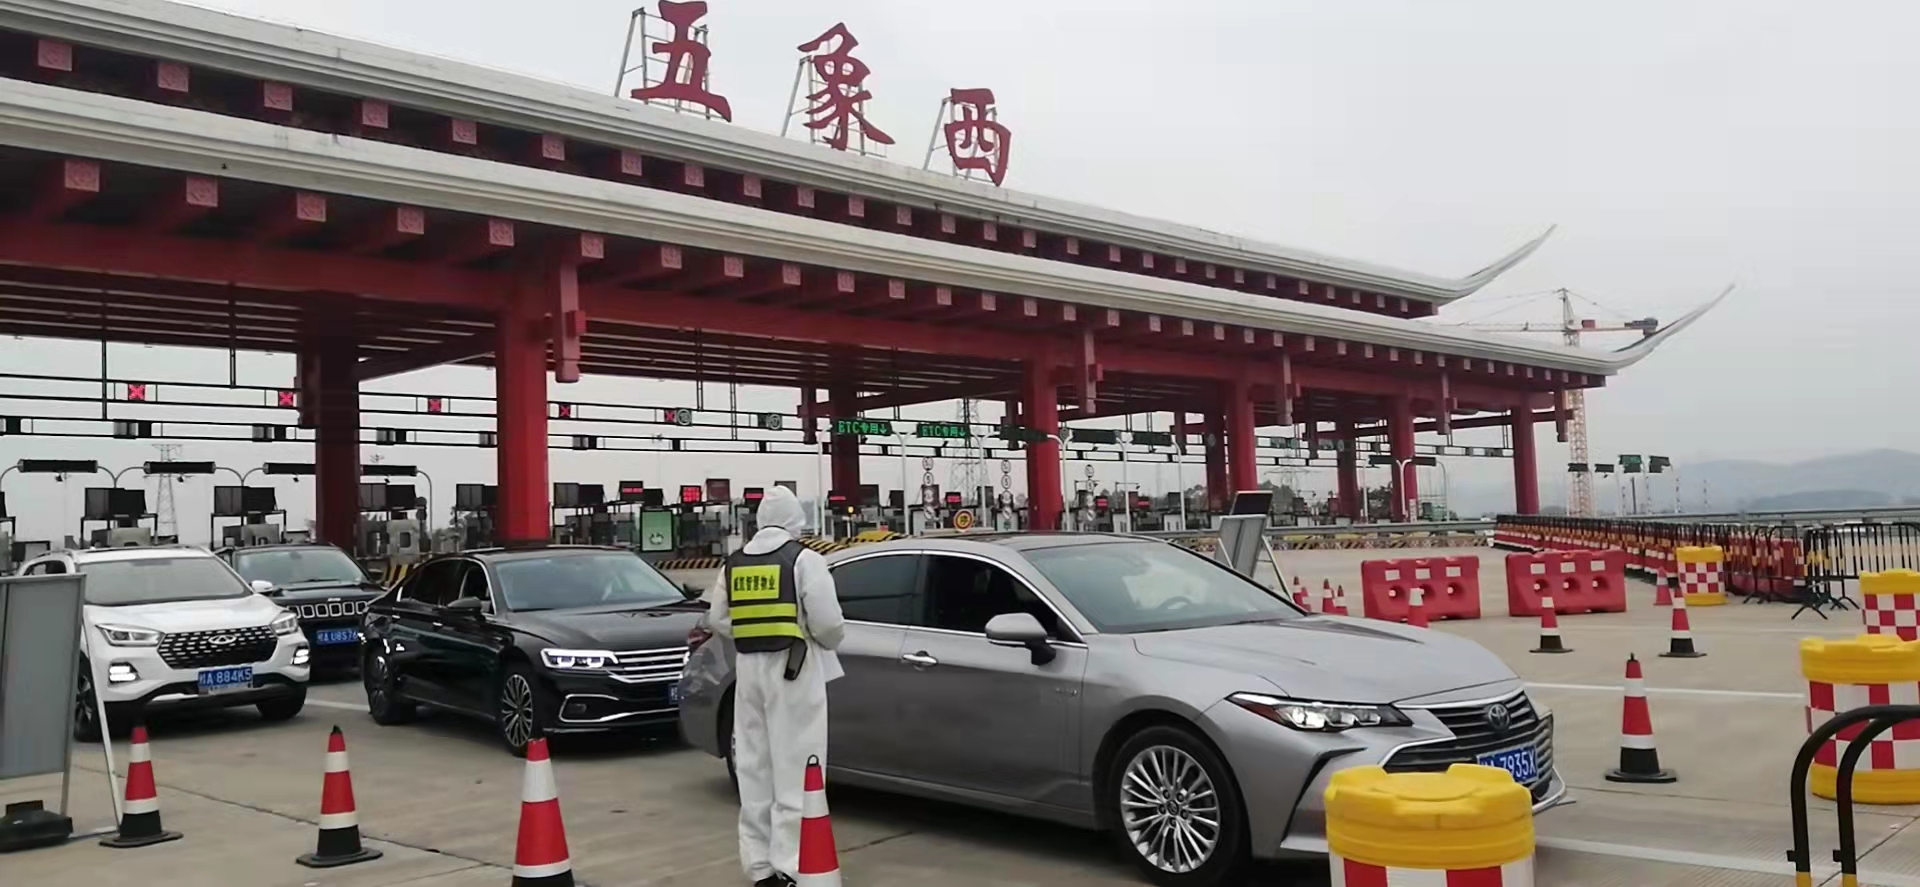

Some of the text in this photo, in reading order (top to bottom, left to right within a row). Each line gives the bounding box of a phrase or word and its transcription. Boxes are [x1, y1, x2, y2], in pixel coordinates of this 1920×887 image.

[631, 0, 1012, 187] 五象西
[1481, 748, 1536, 778] 7935X
